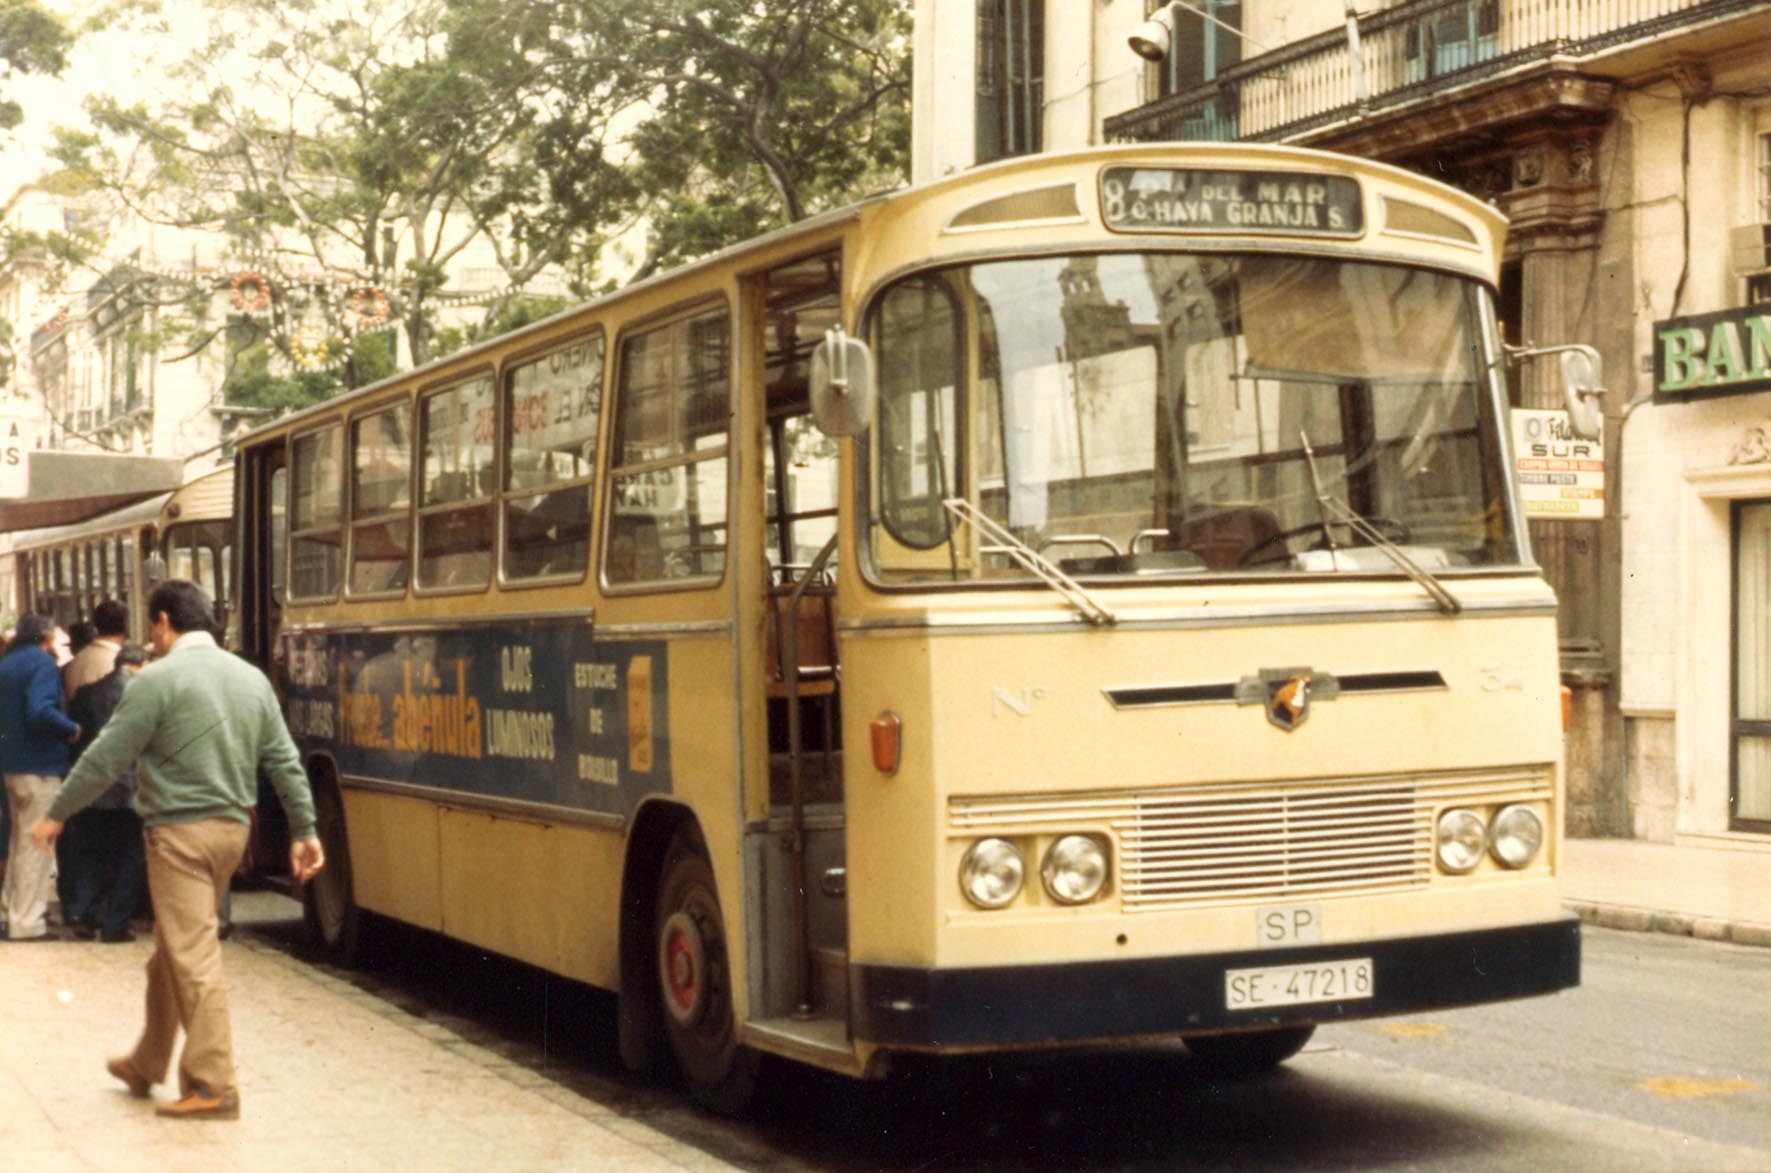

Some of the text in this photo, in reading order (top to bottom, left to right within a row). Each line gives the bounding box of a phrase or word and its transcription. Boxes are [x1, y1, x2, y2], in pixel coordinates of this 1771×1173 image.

[1104, 179, 1126, 221] 8
[1202, 184, 1244, 201] DEL
[1257, 182, 1325, 204] MAR
[1227, 203, 1319, 227] GRANJA
[1531, 444, 1590, 458] SUR
[502, 646, 532, 692] OJOS
[487, 708, 556, 761] LUMINOSOS
[1265, 909, 1313, 941] SP
